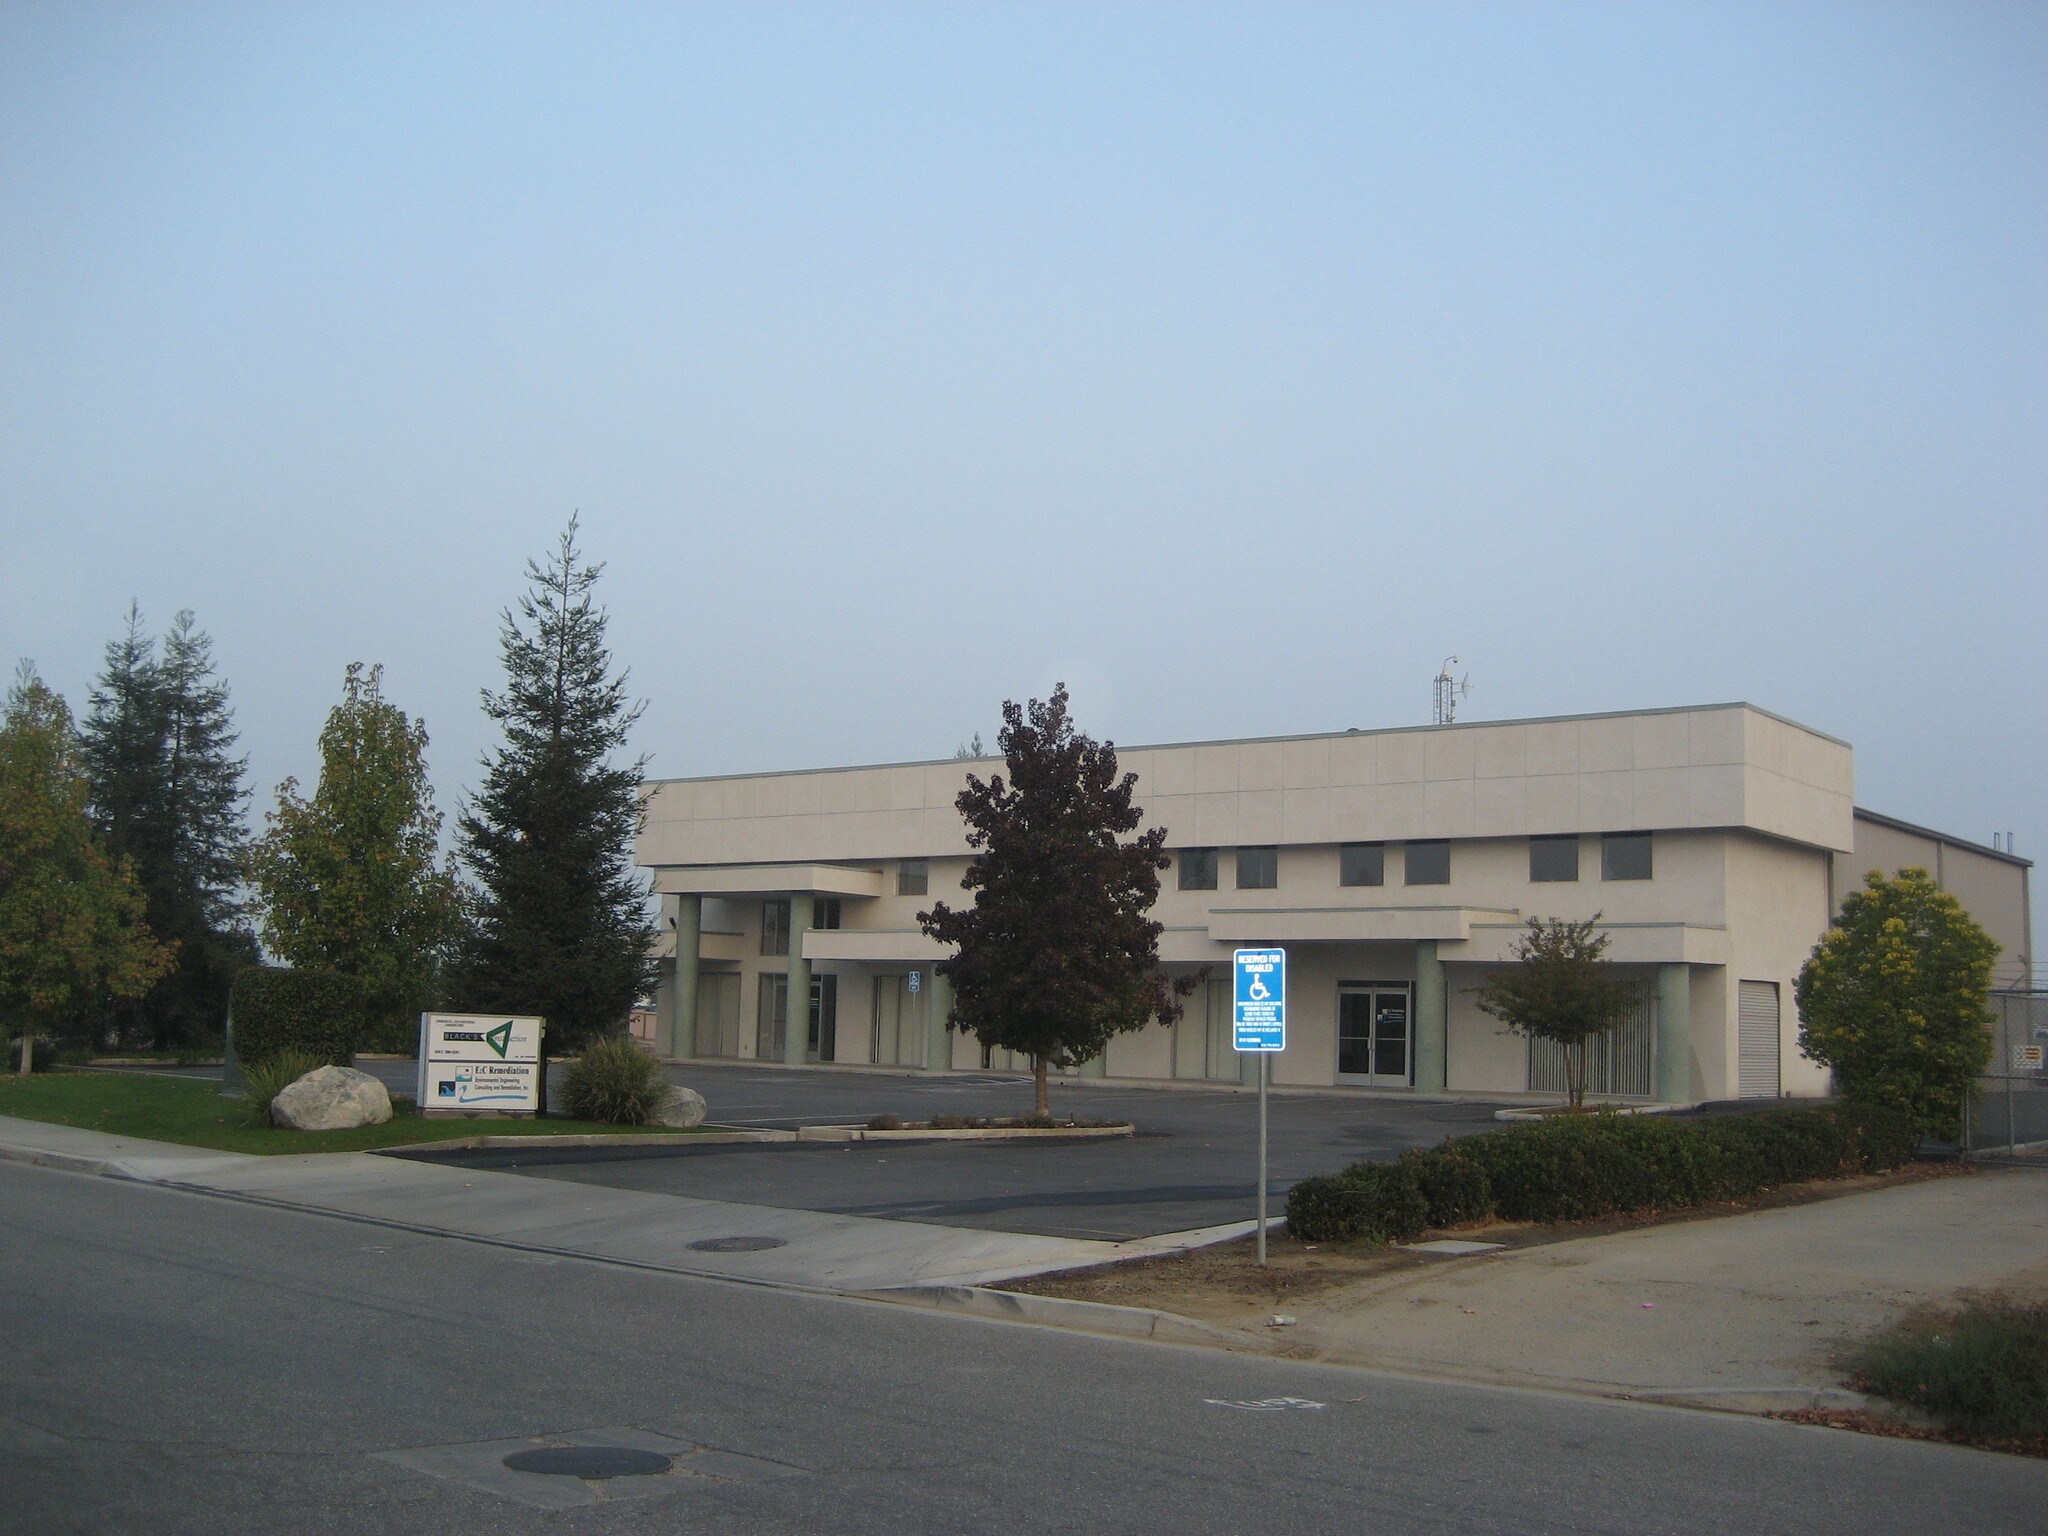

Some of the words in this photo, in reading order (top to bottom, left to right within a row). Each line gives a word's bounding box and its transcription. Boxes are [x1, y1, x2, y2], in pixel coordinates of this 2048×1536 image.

[1238, 955, 1268, 963] RESERVED
[1269, 954, 1281, 963] FOR
[1245, 964, 1273, 972] DISABLED
[489, 1066, 529, 1075] Remediation
